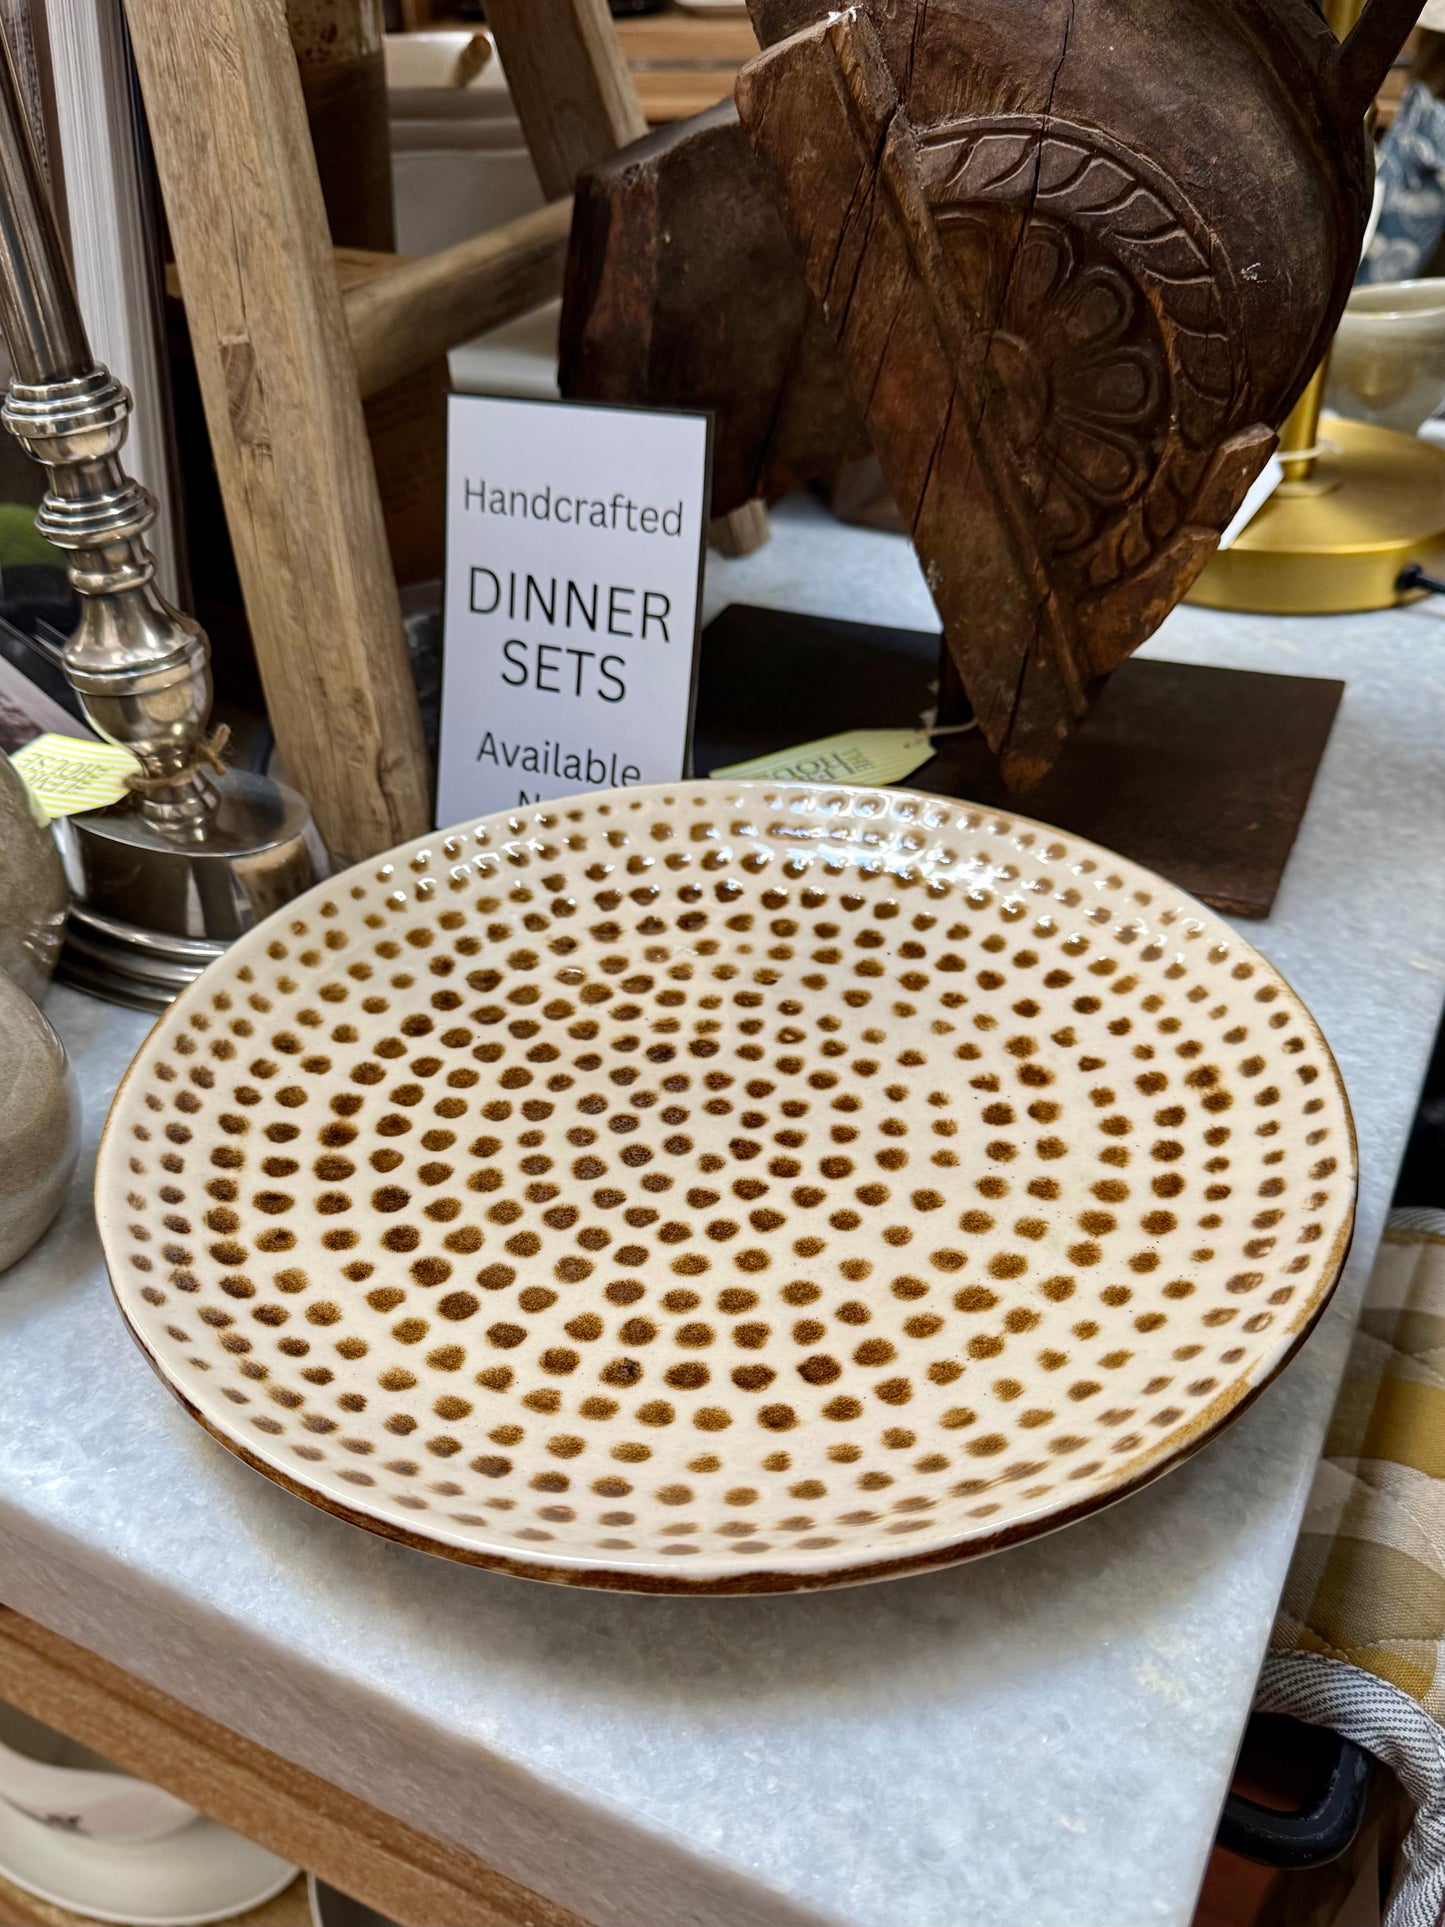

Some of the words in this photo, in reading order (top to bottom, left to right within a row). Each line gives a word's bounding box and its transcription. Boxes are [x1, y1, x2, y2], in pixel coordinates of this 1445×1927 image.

[463, 477, 683, 538] Handcrafted
[469, 565, 671, 644] DINNER
[501, 639, 627, 703] SETS
[476, 731, 642, 788] Available
